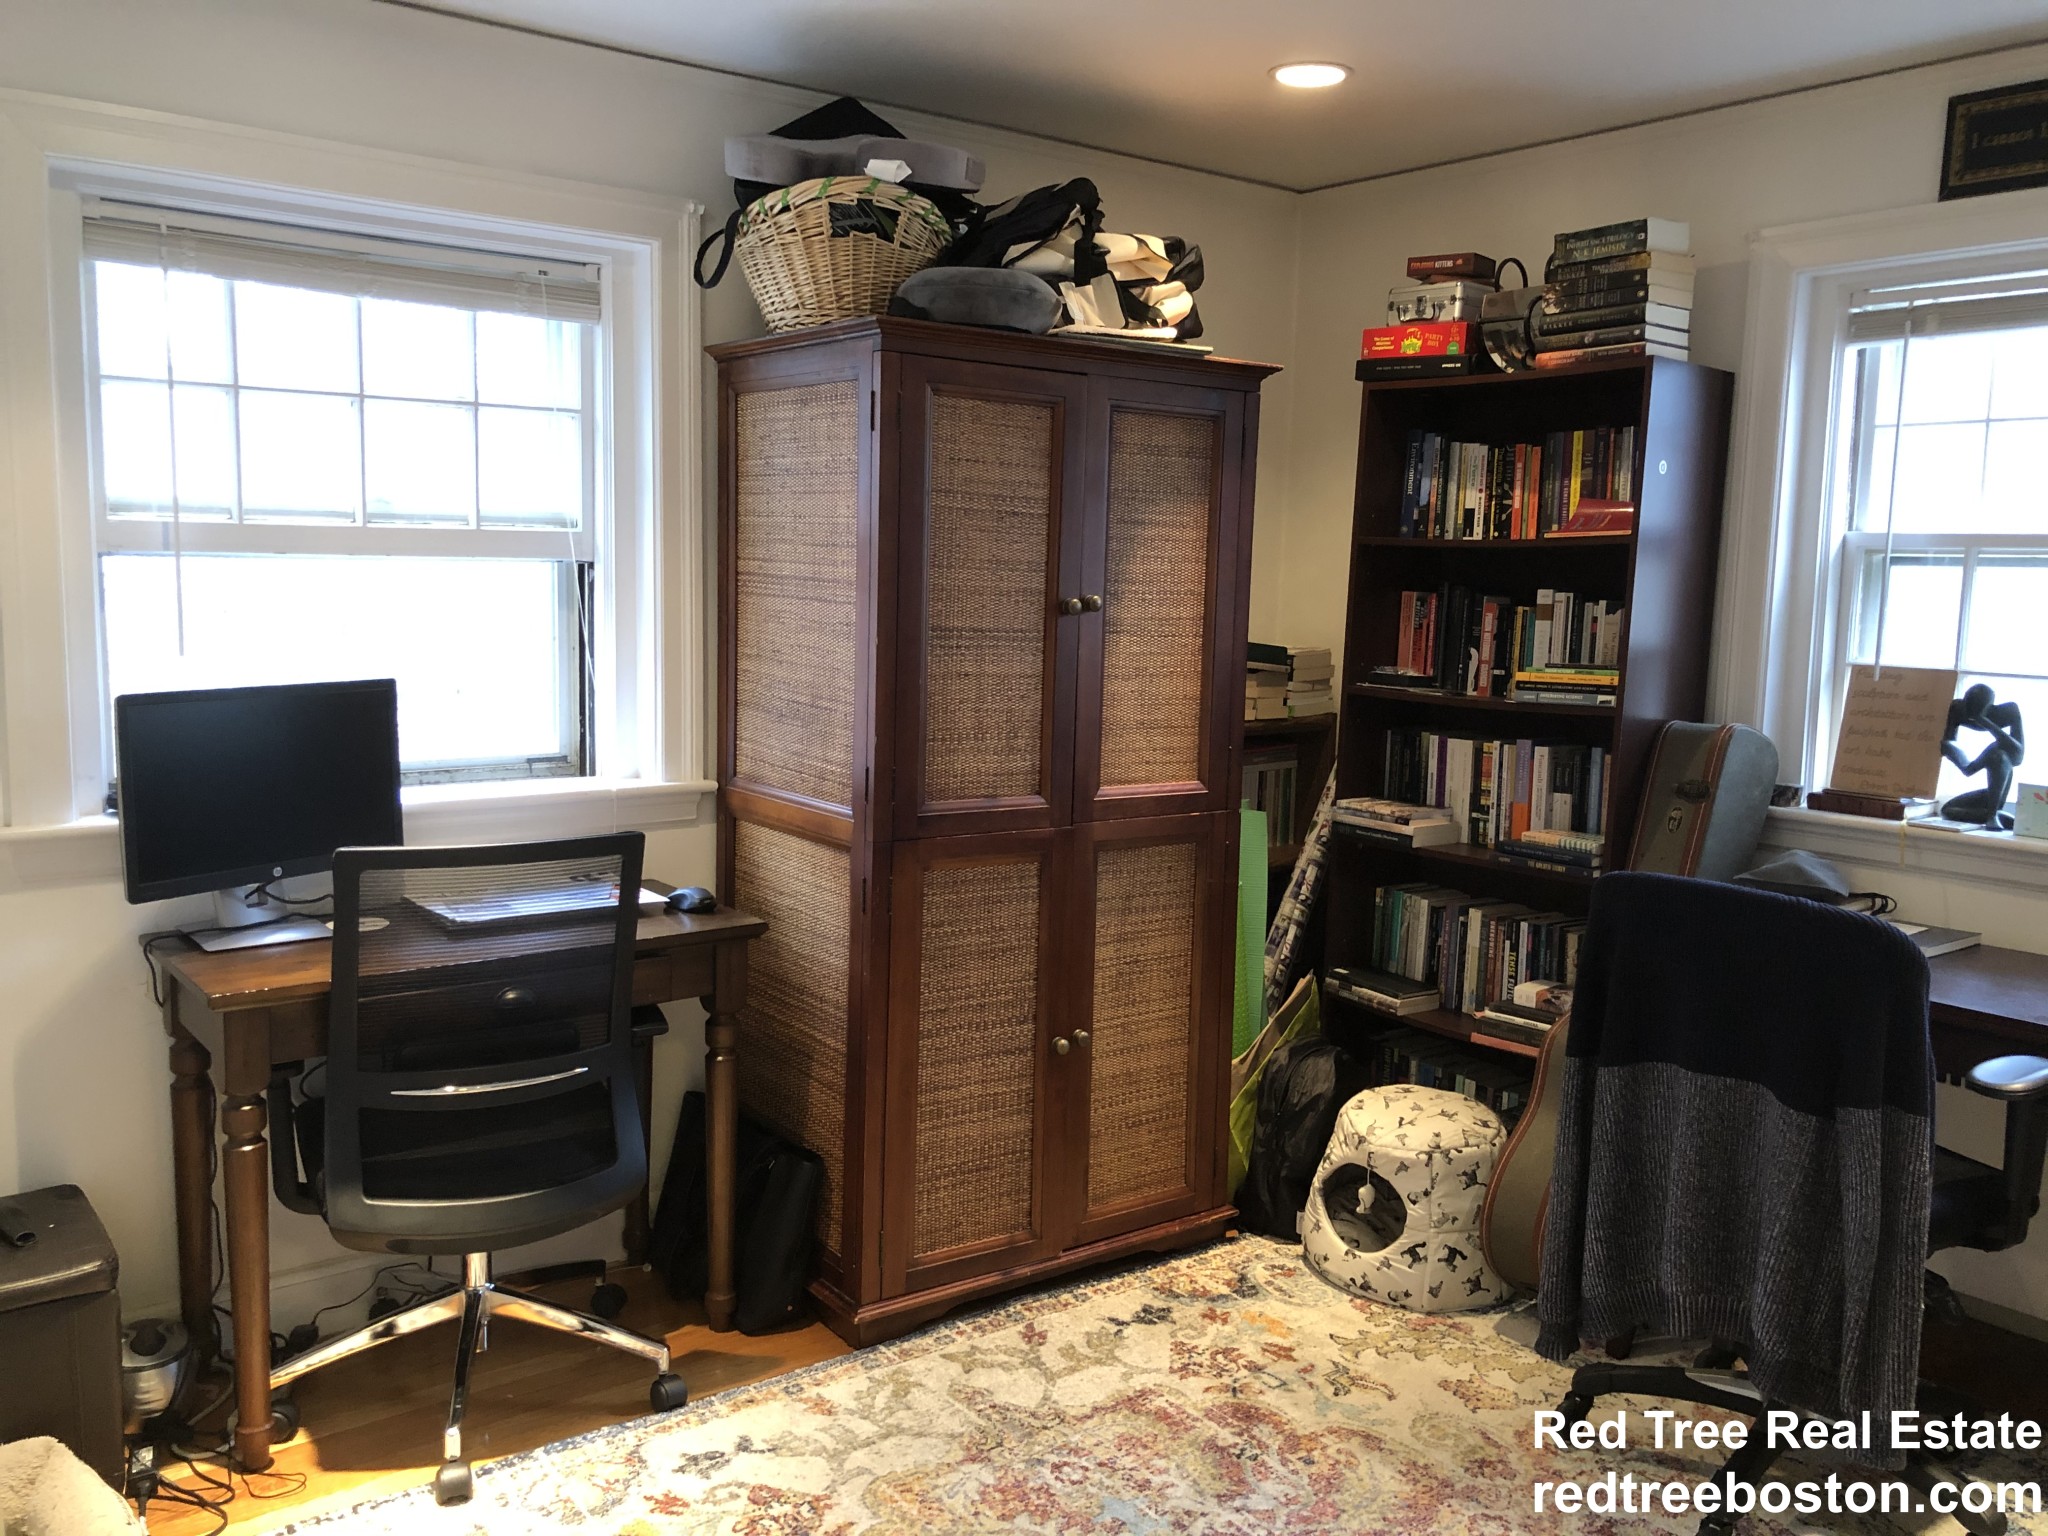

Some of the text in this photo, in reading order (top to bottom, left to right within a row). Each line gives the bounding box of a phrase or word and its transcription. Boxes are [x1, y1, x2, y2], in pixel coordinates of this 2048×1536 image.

[1592, 241, 1627, 256] JEMISIN
[1434, 259, 1454, 269] KITTENS
[1407, 442, 1420, 496] Environment
[1537, 753, 1545, 784] Foucault
[1488, 920, 1496, 958] UNKNOWING
[1508, 951, 1516, 977] TENSE
